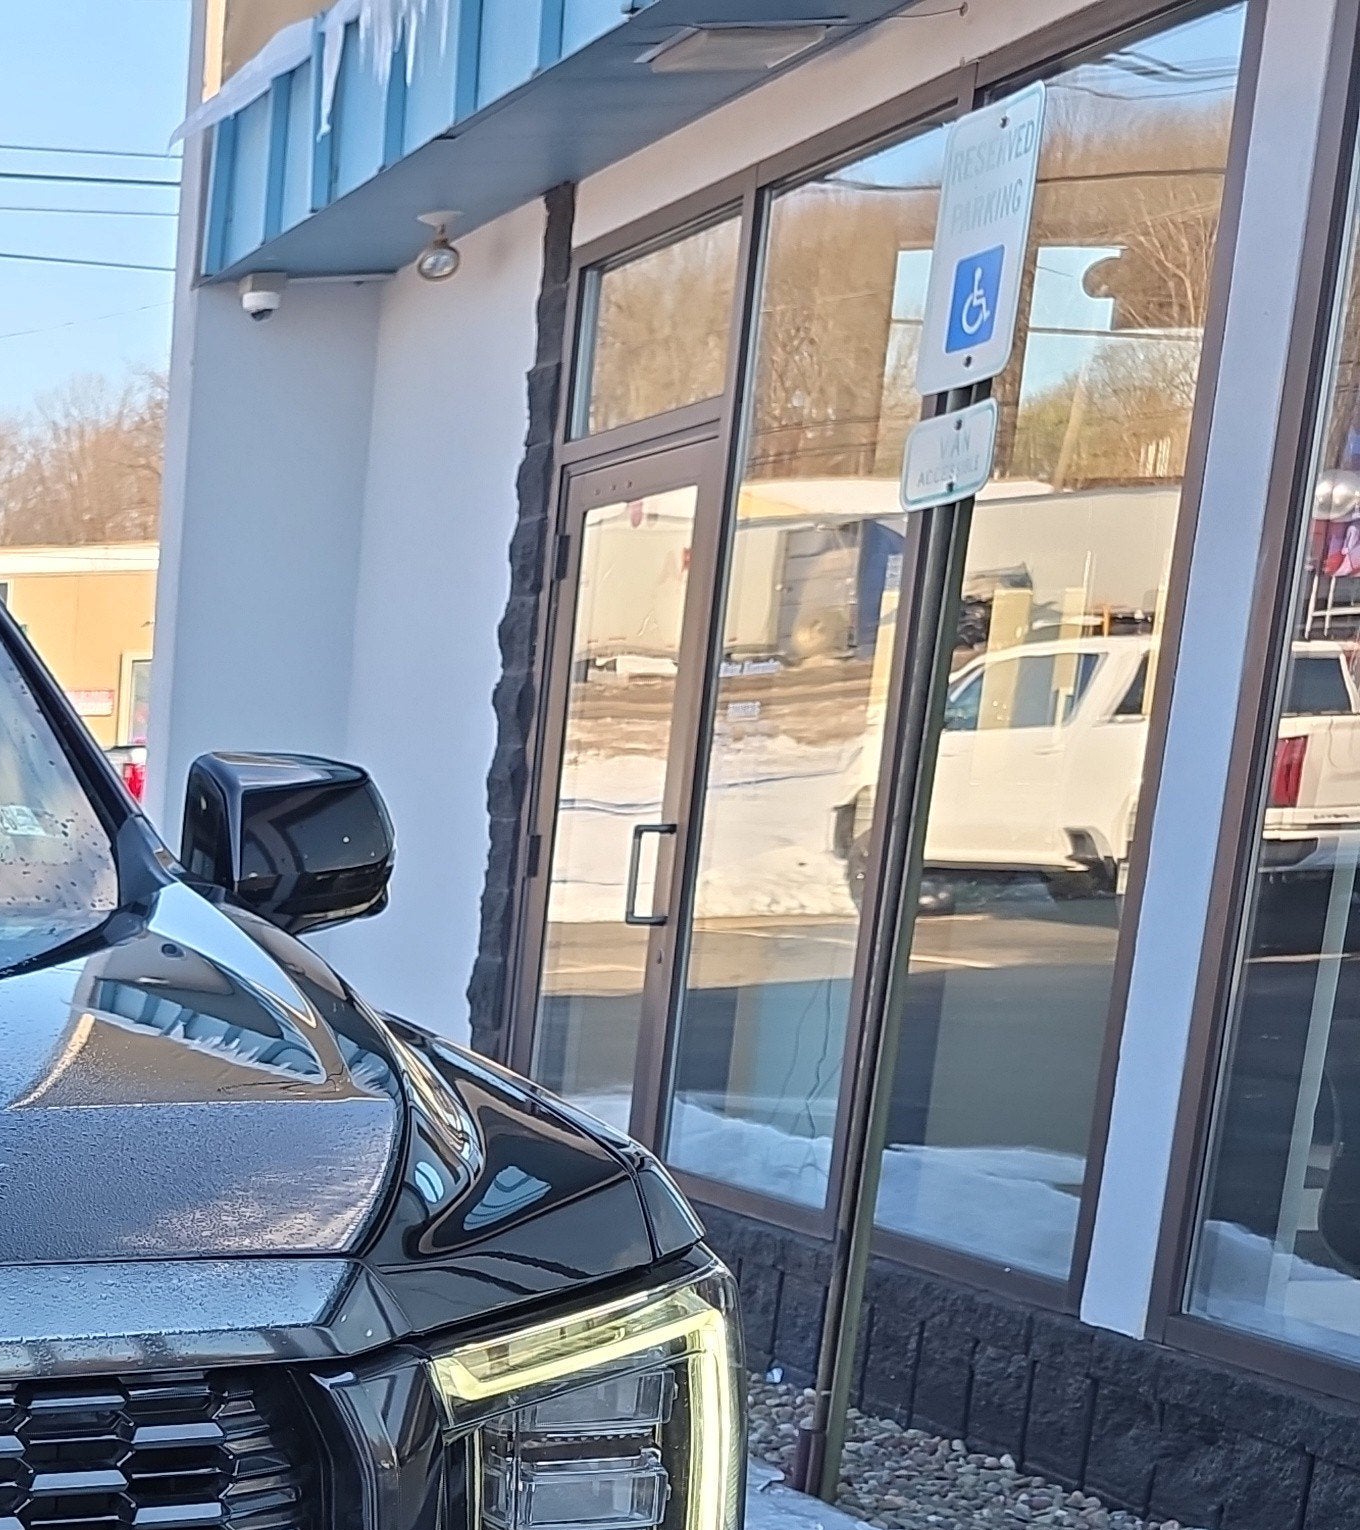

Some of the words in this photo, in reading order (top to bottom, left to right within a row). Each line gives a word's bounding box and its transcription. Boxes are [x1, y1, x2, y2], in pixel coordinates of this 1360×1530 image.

[951, 119, 1036, 185] RESERVED
[949, 178, 1024, 237] PARKING
[939, 427, 972, 459] VAN
